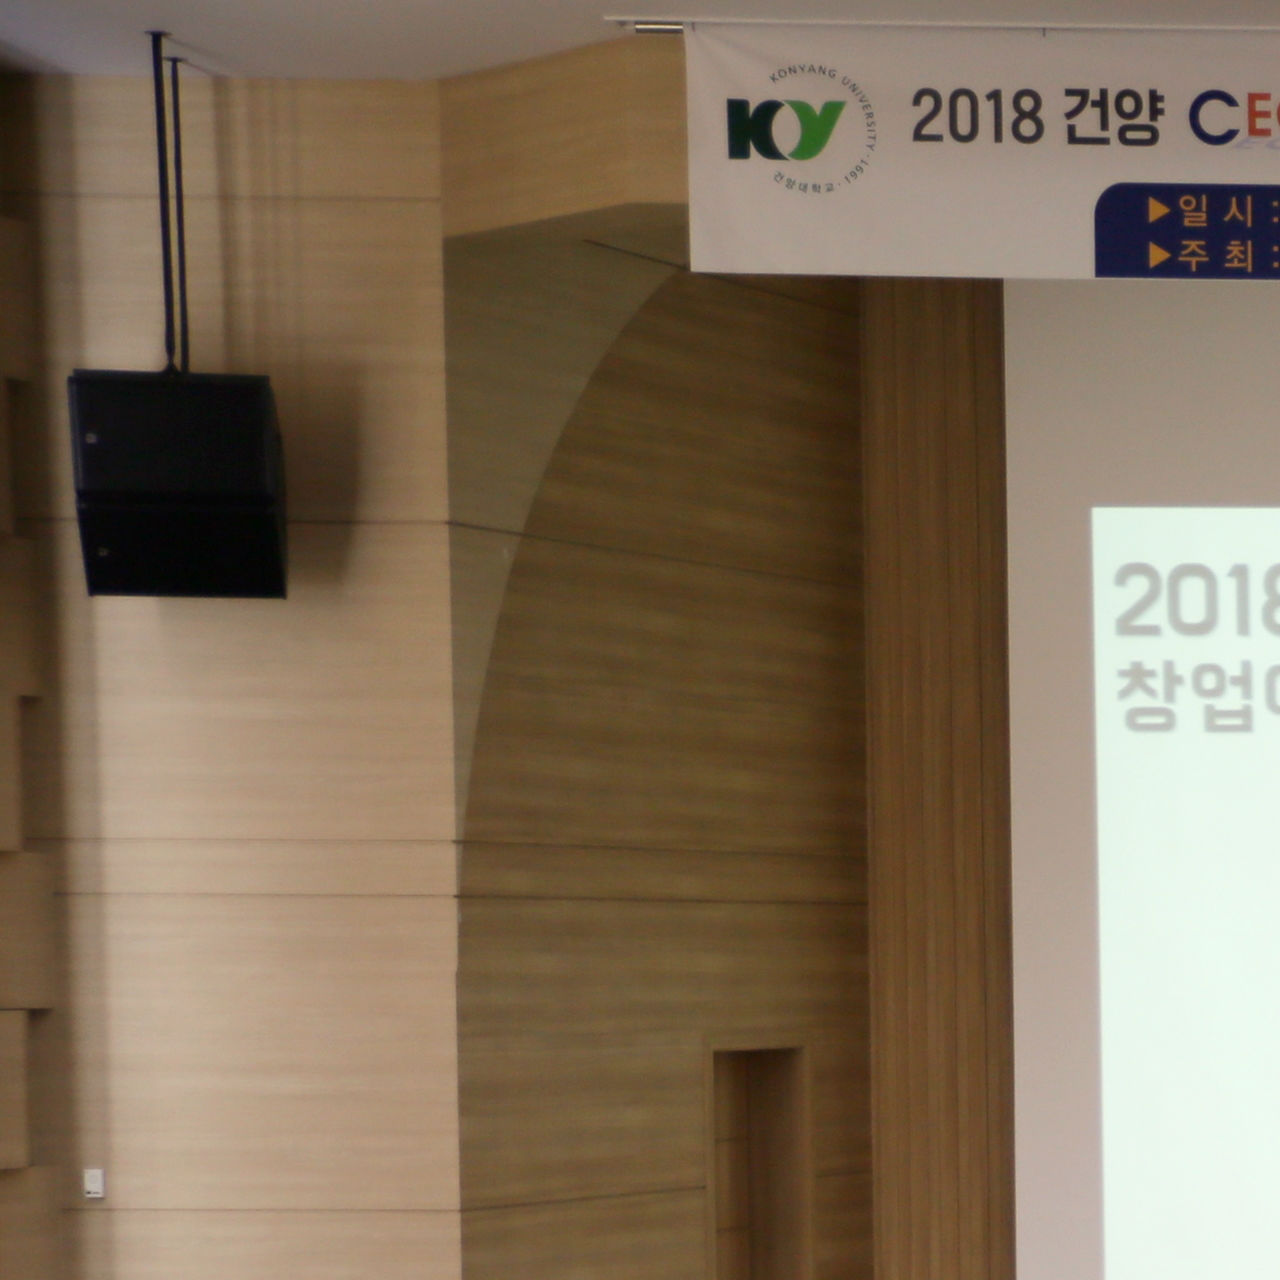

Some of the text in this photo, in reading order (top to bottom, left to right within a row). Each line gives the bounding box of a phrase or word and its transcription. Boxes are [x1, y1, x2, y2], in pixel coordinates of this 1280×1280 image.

[726, 97, 848, 161] KY
[769, 64, 878, 152] KONYANG UNIVERSITY
[911, 87, 1045, 144] 2018
[1064, 88, 1166, 147] 건양
[773, 170, 835, 194] 건양대학교
